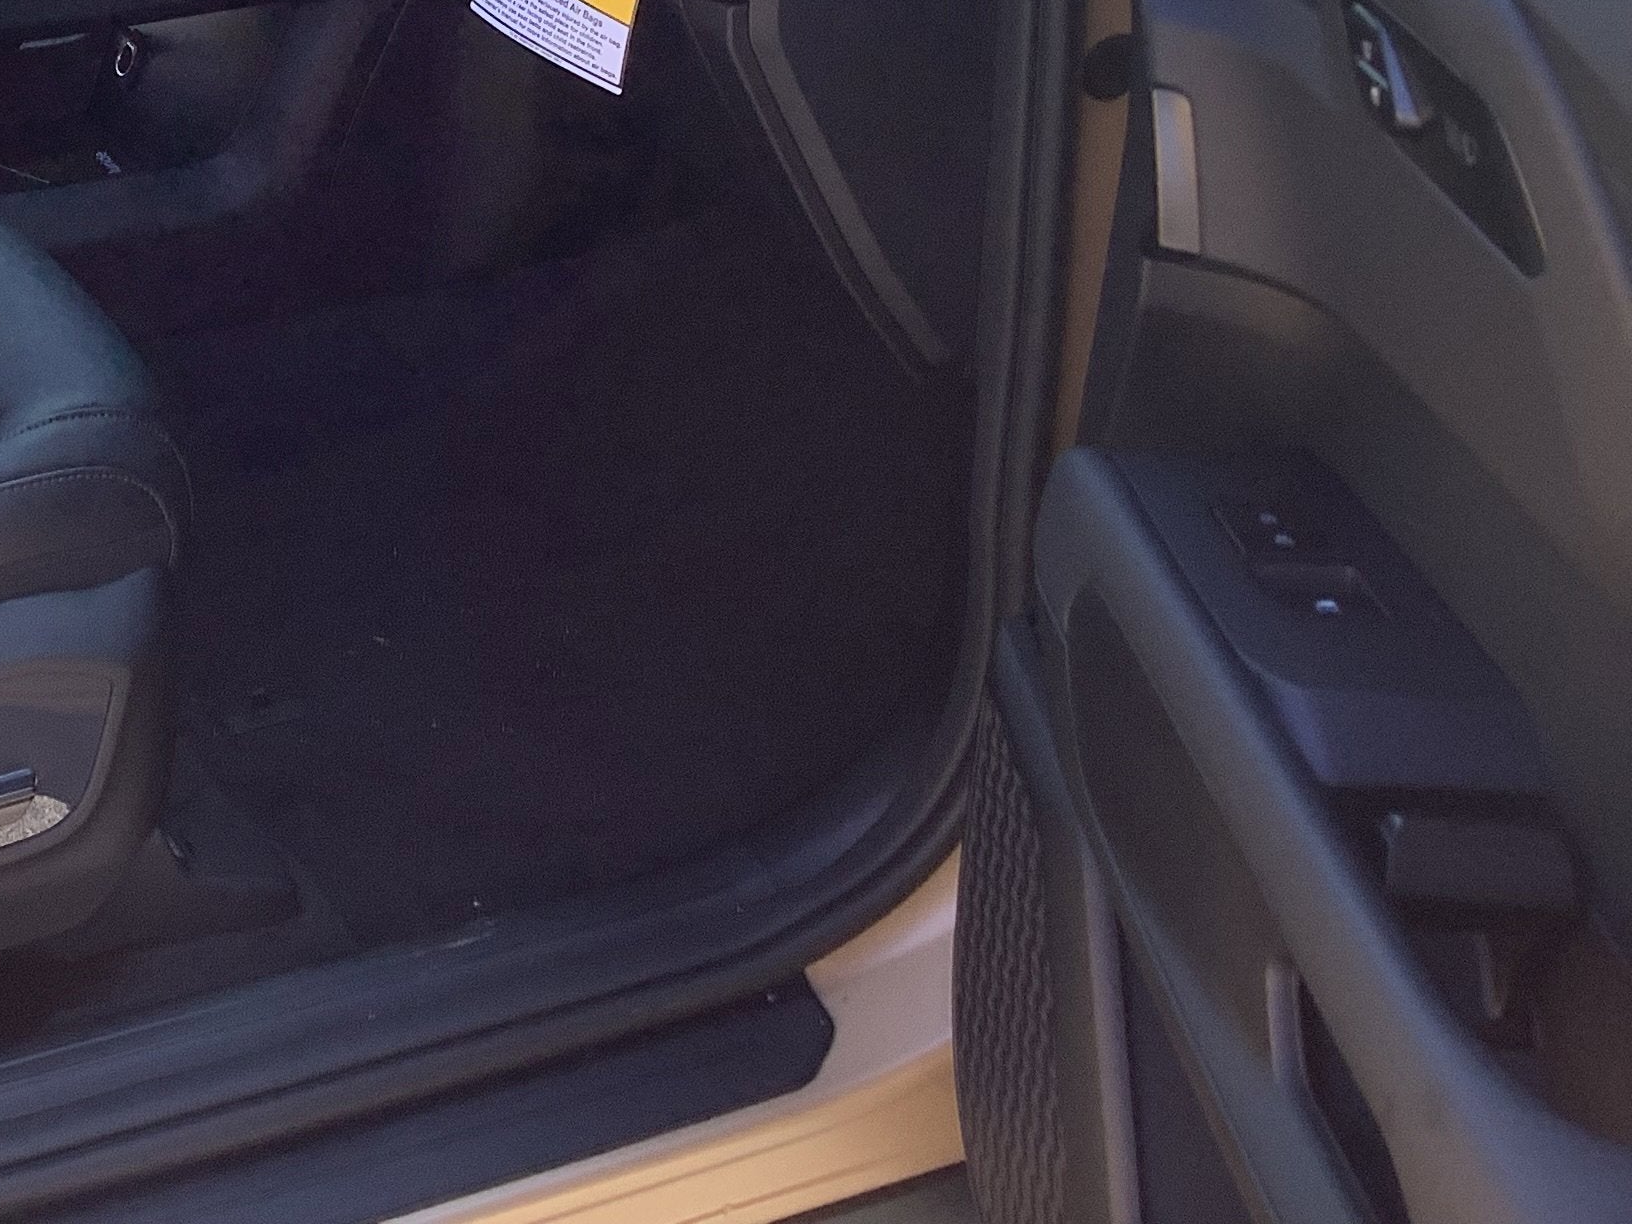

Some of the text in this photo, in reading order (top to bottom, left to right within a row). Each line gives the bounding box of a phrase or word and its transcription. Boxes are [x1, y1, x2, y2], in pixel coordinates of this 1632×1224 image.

[527, 9, 542, 22] facing
[539, 8, 553, 19] safest
[555, 17, 568, 28] place
[571, 3, 580, 14] Air
[583, 10, 602, 27] Bags
[562, 13, 580, 26] injured
[609, 38, 620, 48] bag.
[574, 54, 589, 64] about
